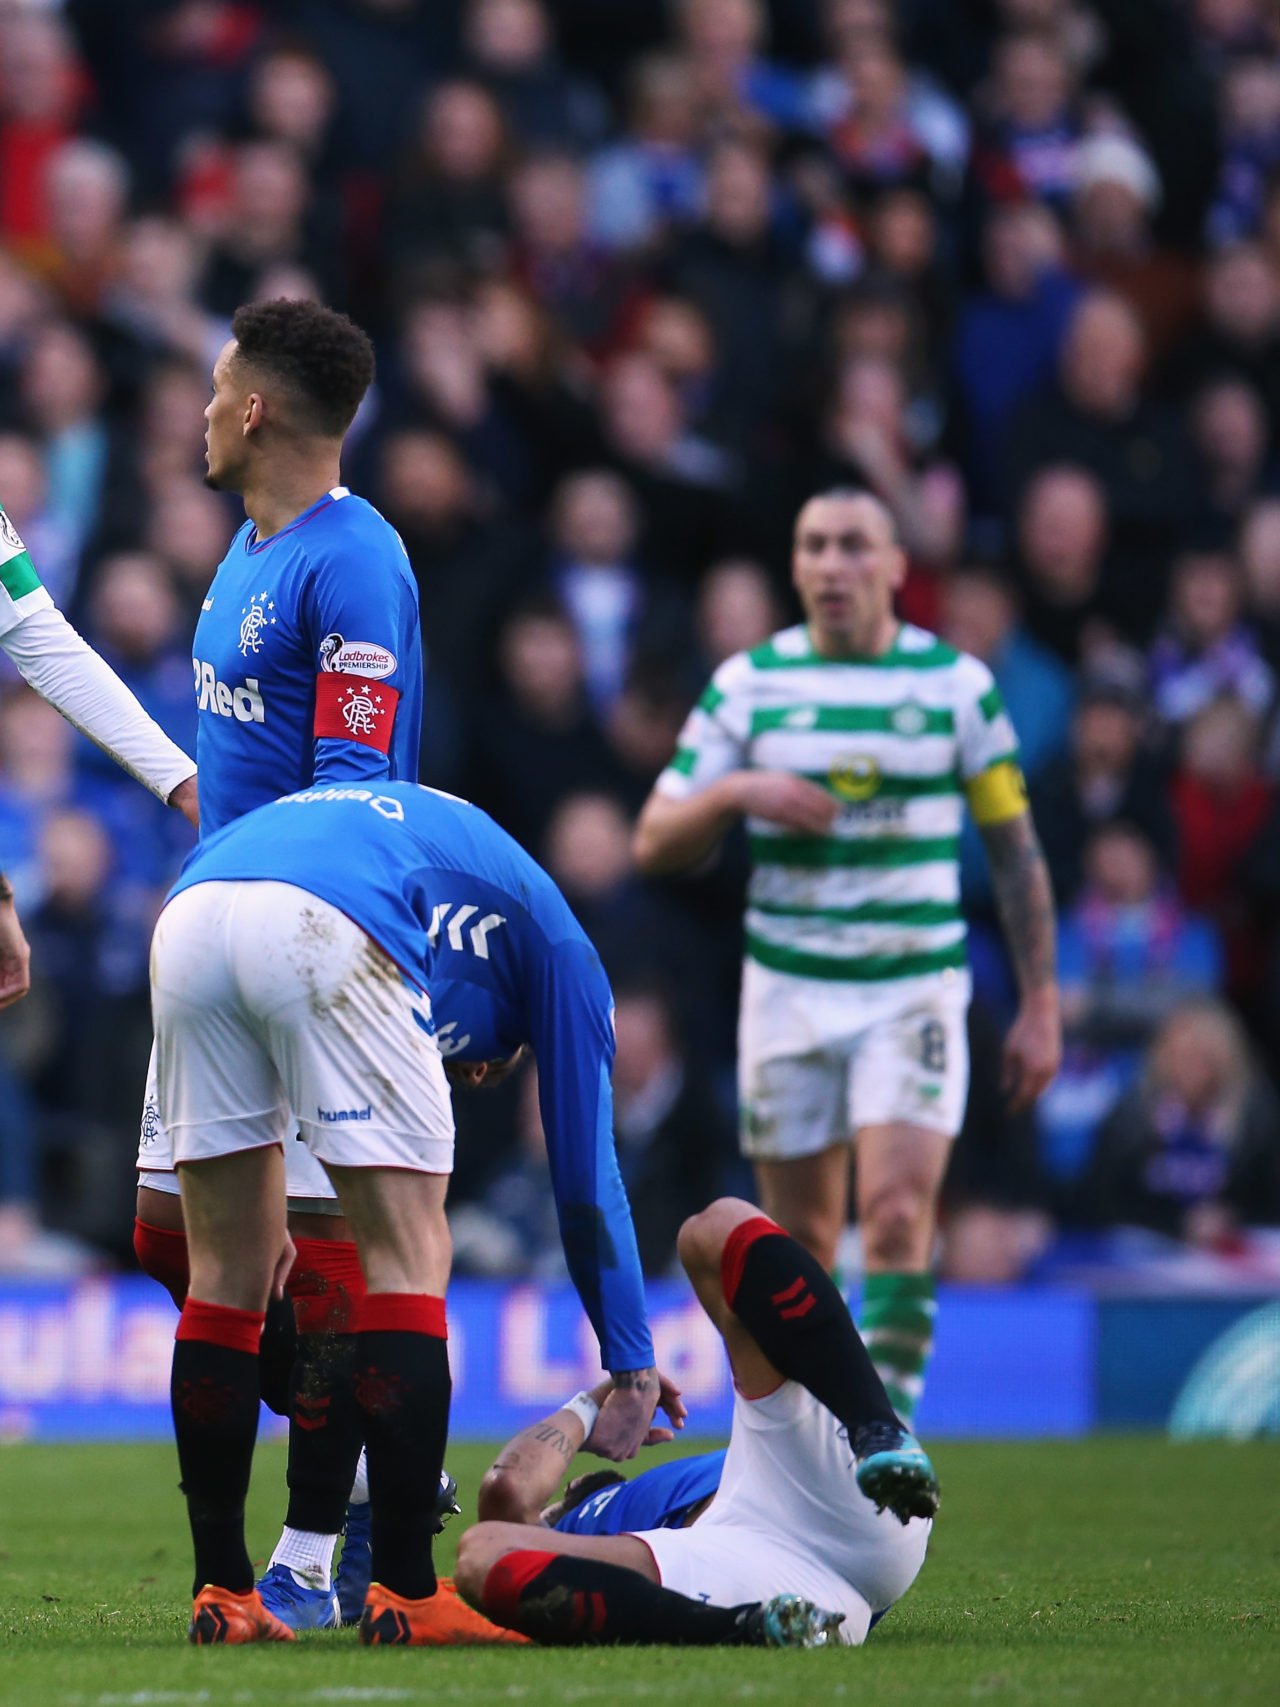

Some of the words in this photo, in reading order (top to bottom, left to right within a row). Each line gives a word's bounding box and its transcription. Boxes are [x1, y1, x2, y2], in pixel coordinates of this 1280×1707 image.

[338, 651, 390, 663] Ladbrokes
[338, 662, 389, 670] PREMIERSHIP
[317, 1105, 371, 1121] hummel
